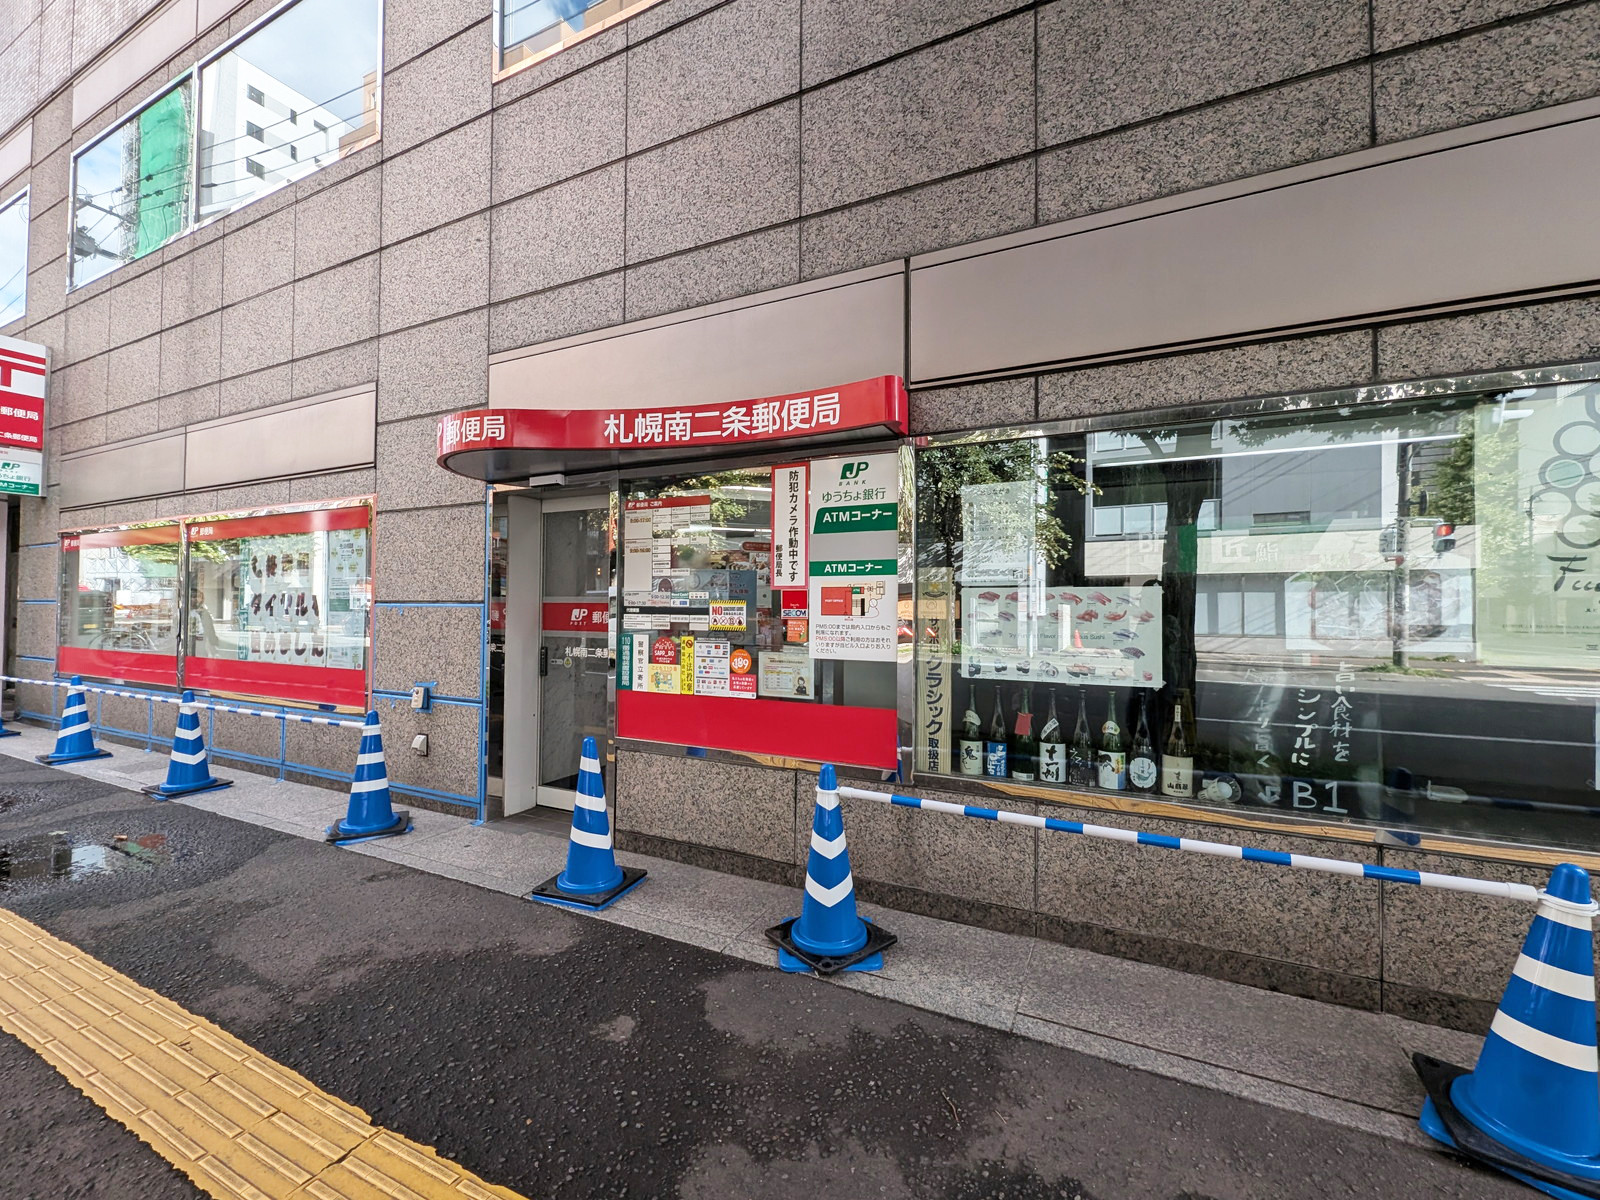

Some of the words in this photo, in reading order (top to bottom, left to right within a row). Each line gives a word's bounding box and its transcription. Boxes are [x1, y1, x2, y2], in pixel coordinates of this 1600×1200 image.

[0, 406, 39, 421] 郵便局
[603, 392, 841, 444] 札幌南二条郵便局
[446, 415, 505, 446] 郵便局
[822, 487, 886, 503] ゆうちょ銀行
[788, 470, 799, 582] 防犯カメラ作動中です
[823, 508, 893, 523] ATMコーナー
[775, 544, 783, 577] 郵便局長
[1255, 542, 1279, 563] 鮨
[824, 562, 882, 573] ATMコーナー
[712, 606, 723, 616] NO
[783, 609, 806, 617] SECOM
[1330, 661, 1356, 762] 旨い食材を
[1291, 688, 1321, 767] シンプルに
[1293, 780, 1348, 814] B1
